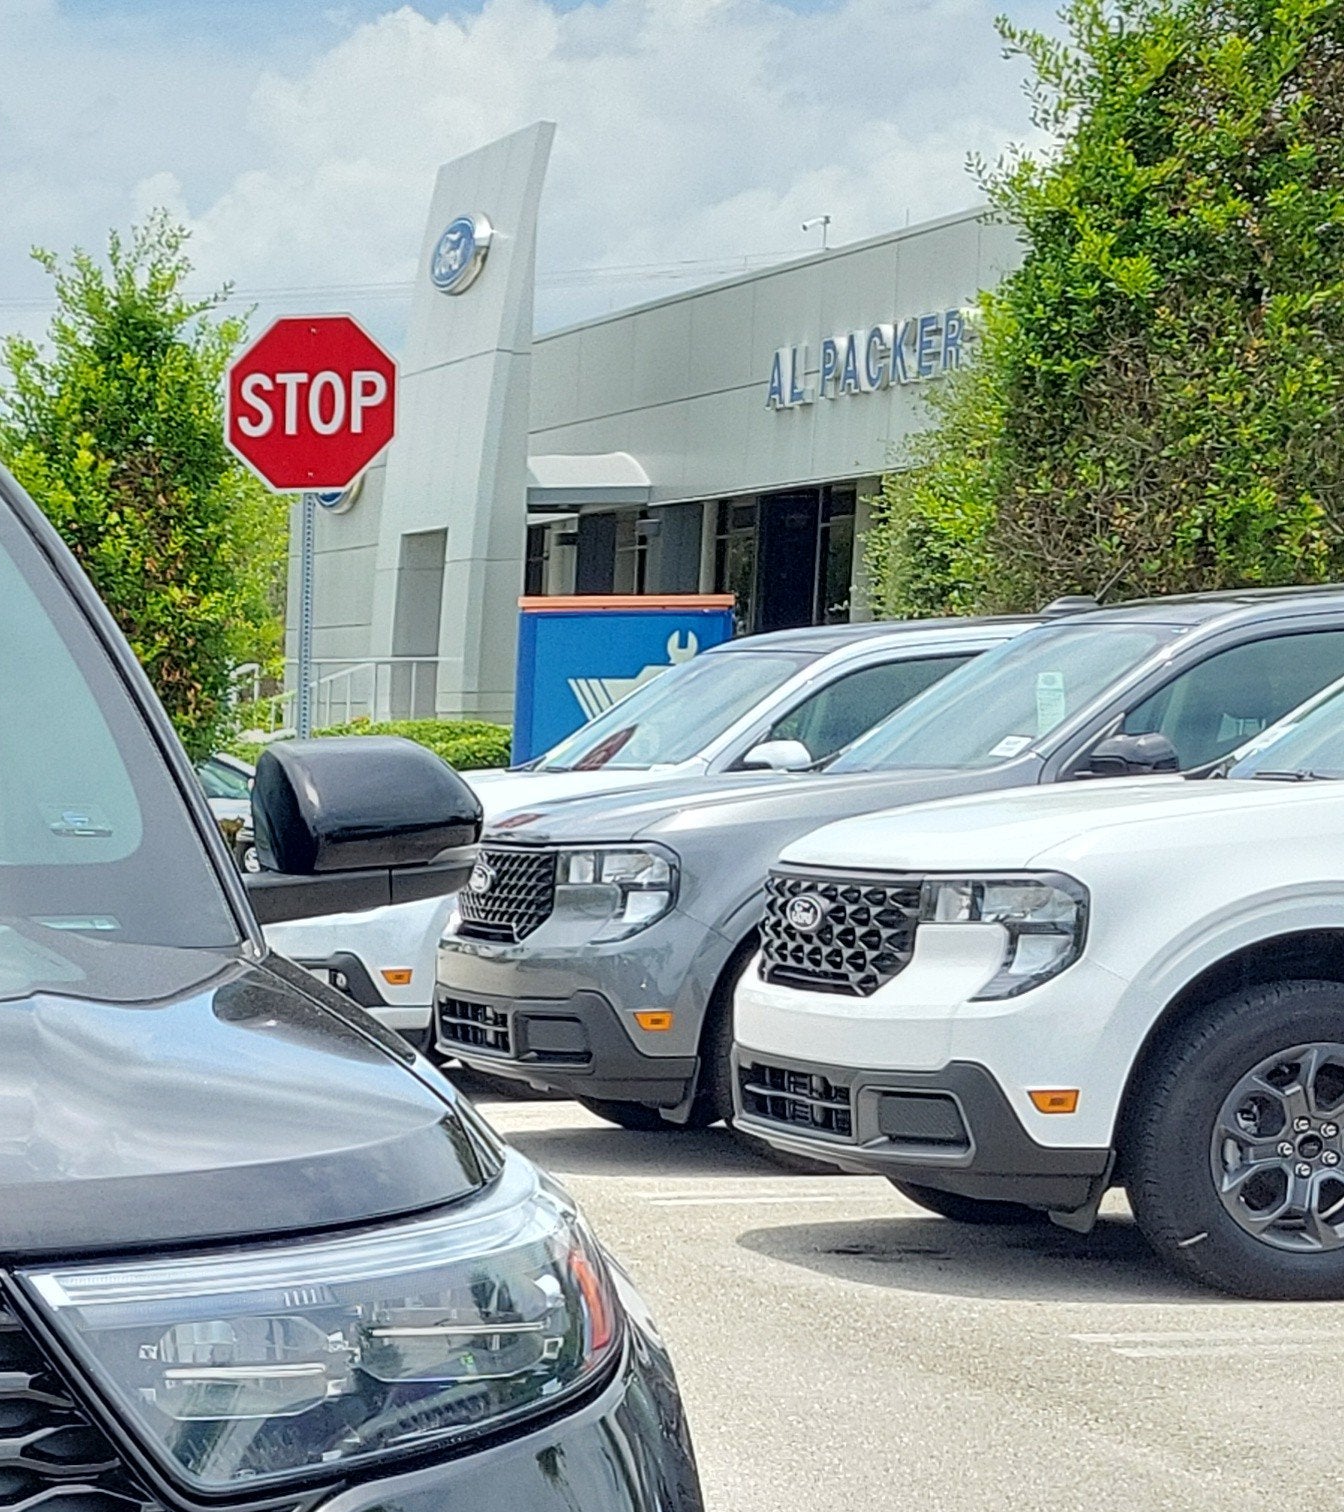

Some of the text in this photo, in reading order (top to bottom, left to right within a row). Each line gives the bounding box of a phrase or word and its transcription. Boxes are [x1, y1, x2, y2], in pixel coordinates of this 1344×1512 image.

[765, 307, 964, 411] AL PACKER
[237, 370, 388, 438] STOP
